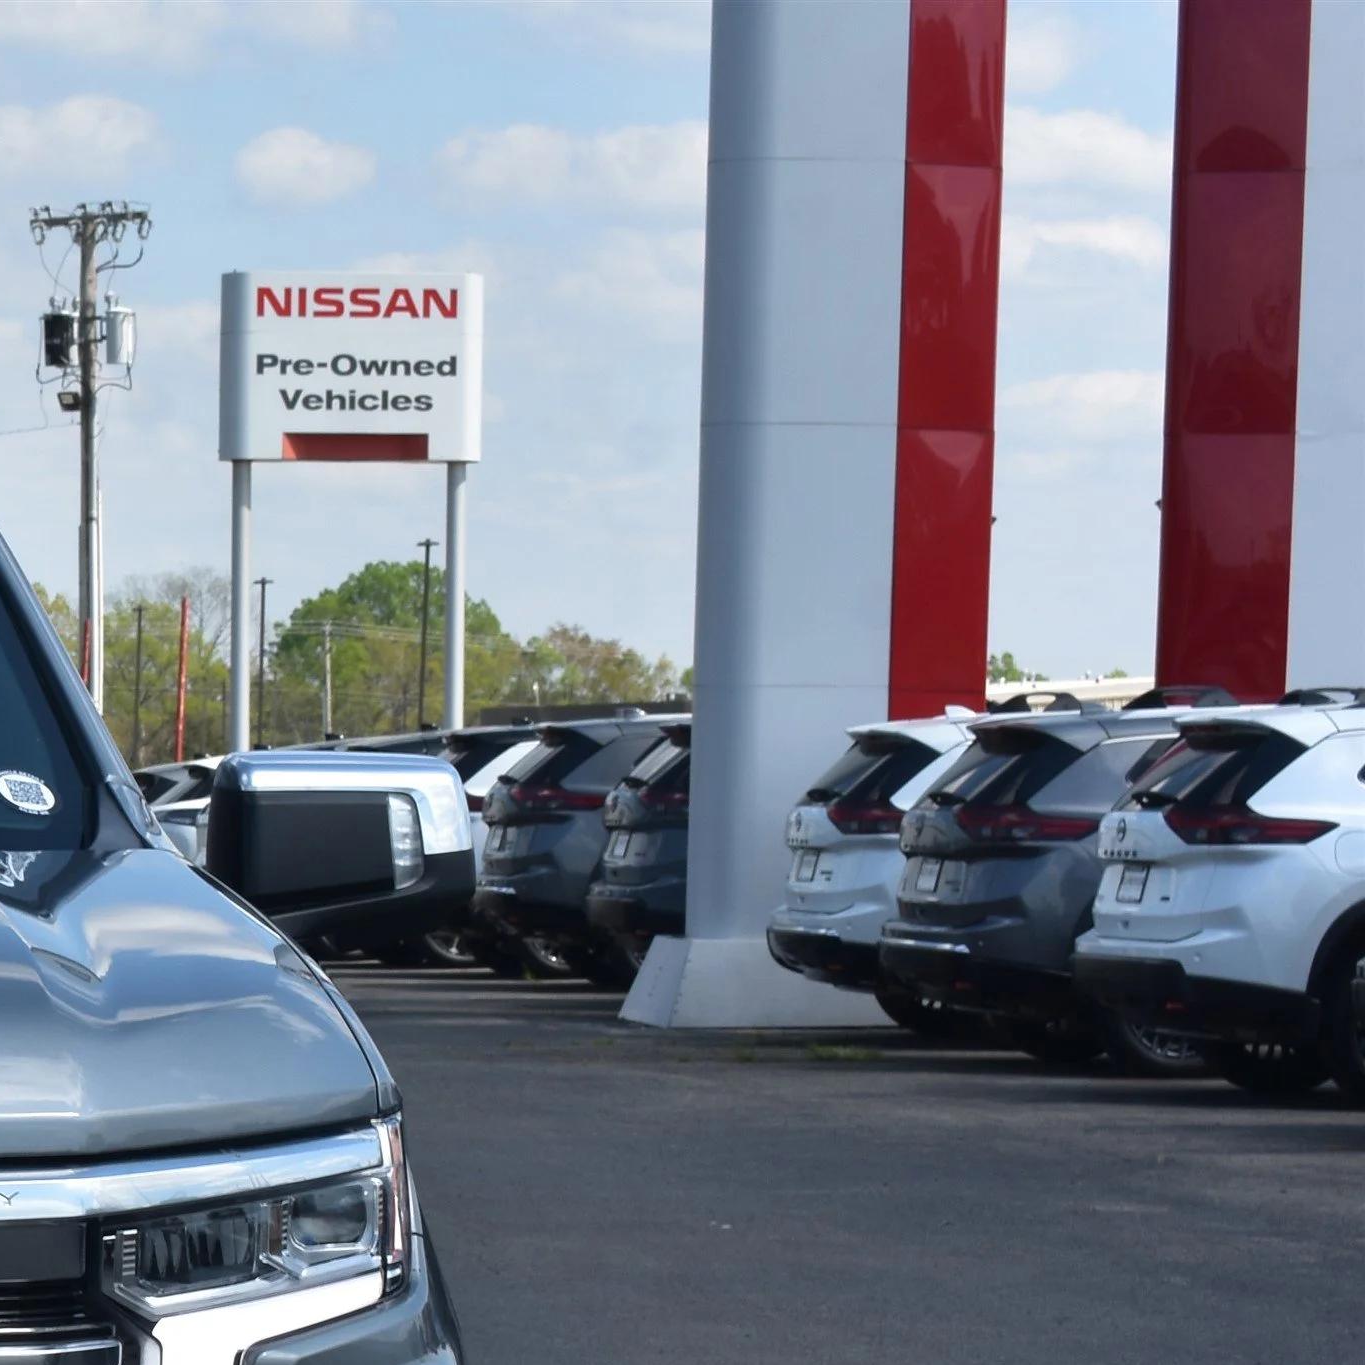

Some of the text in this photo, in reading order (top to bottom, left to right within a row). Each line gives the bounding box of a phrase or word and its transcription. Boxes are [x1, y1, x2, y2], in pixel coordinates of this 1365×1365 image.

[256, 287, 458, 319] NISSAN
[256, 353, 458, 377] Pre-Owned
[279, 388, 434, 412] Vehicles
